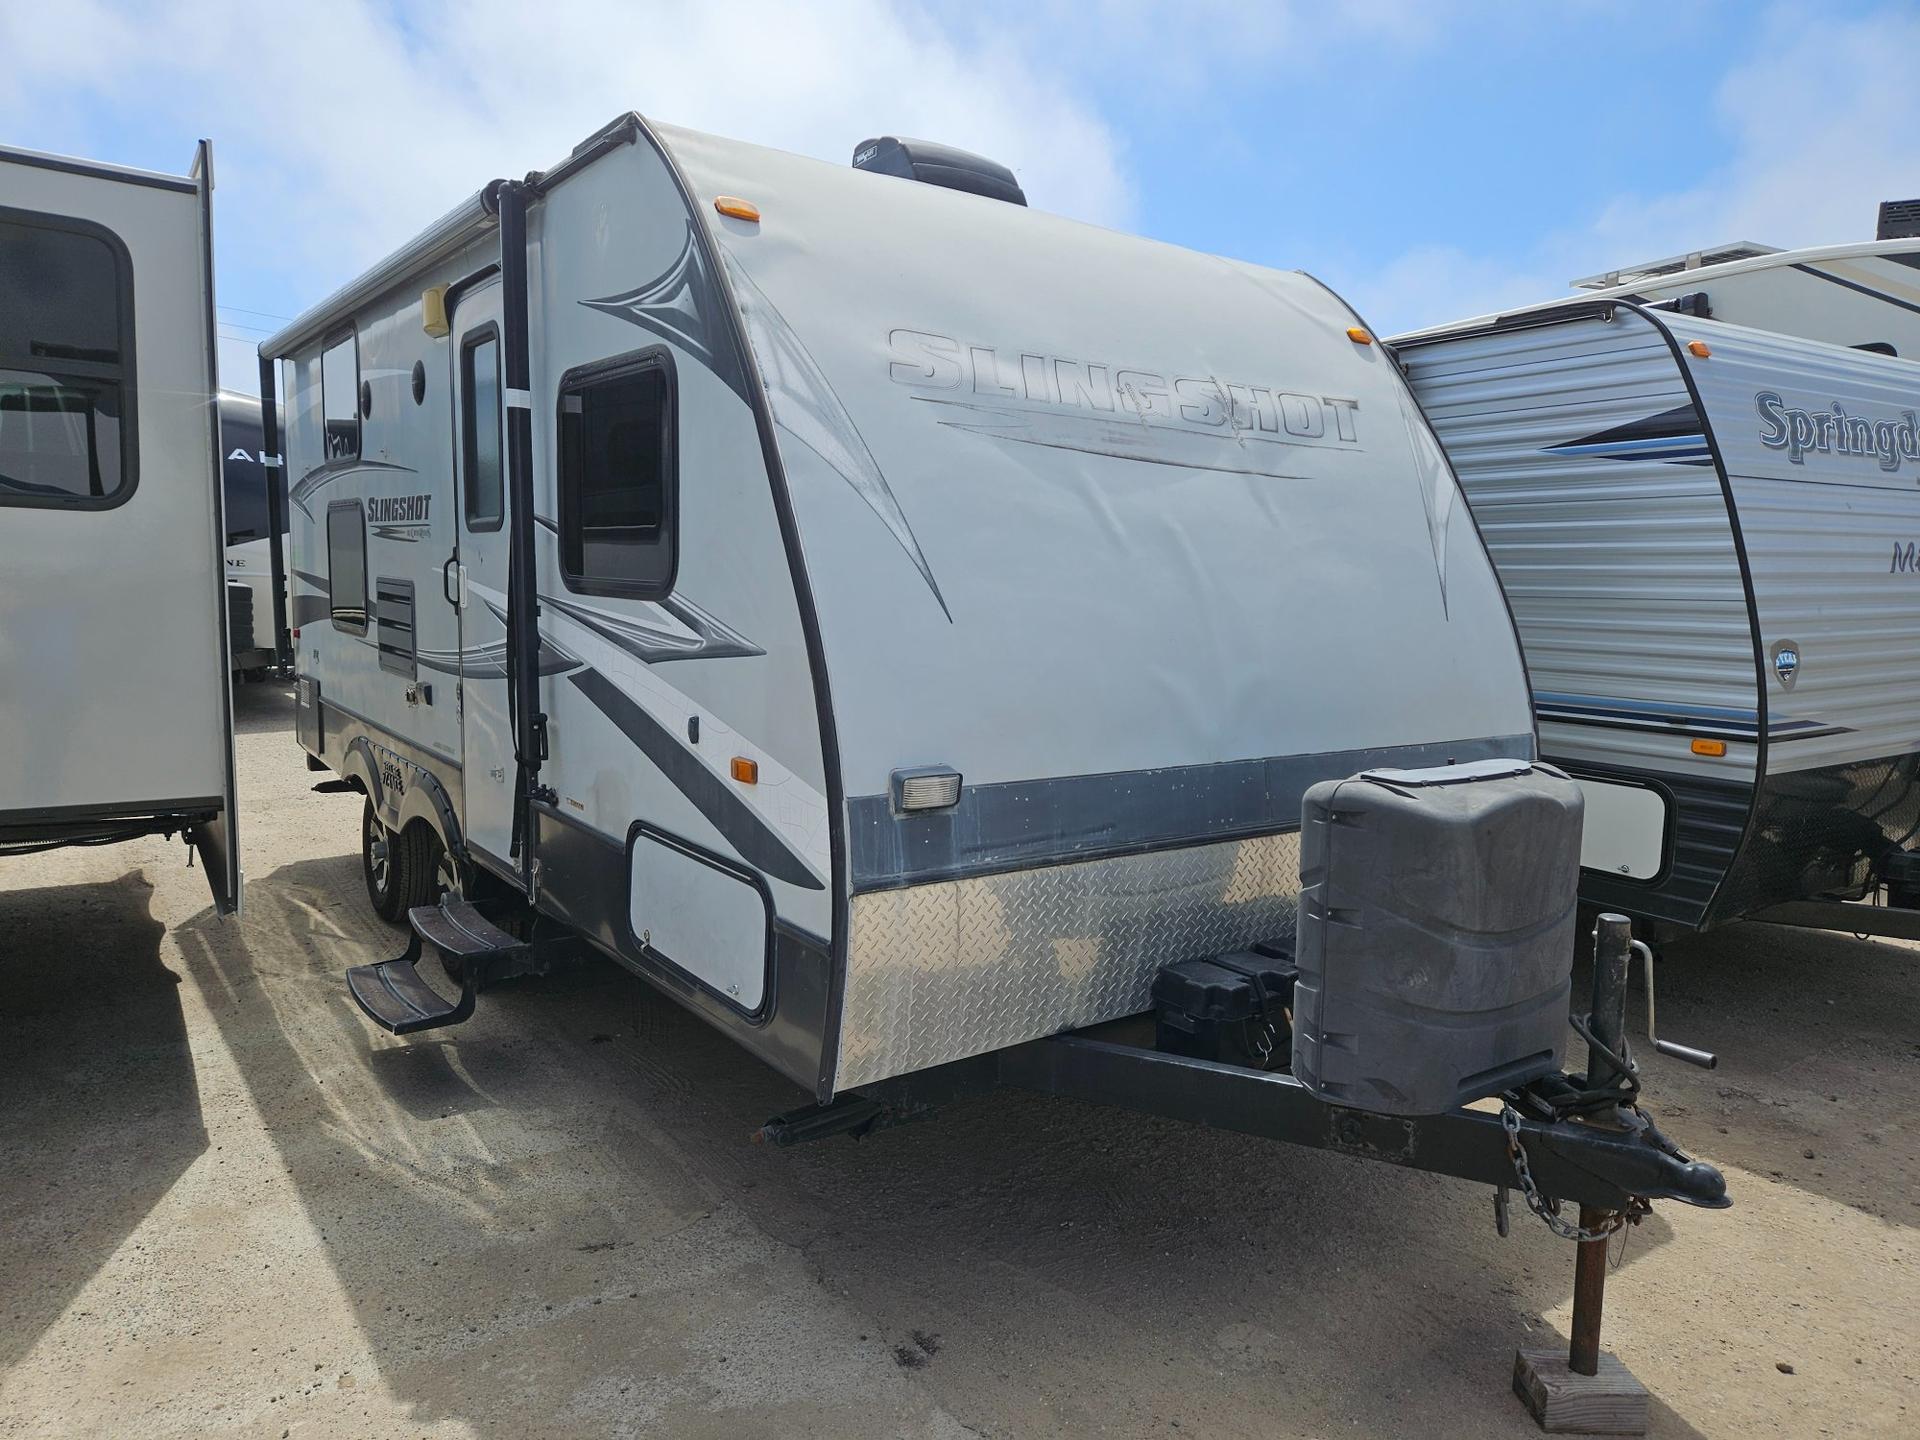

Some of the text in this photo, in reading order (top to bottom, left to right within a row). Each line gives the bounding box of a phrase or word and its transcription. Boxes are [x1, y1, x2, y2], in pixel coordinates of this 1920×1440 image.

[889, 328, 1359, 443] SLINGSHOT
[1755, 391, 1920, 472] Springd
[367, 494, 432, 522] SLINGSHOT
[1889, 541, 1920, 574] M
